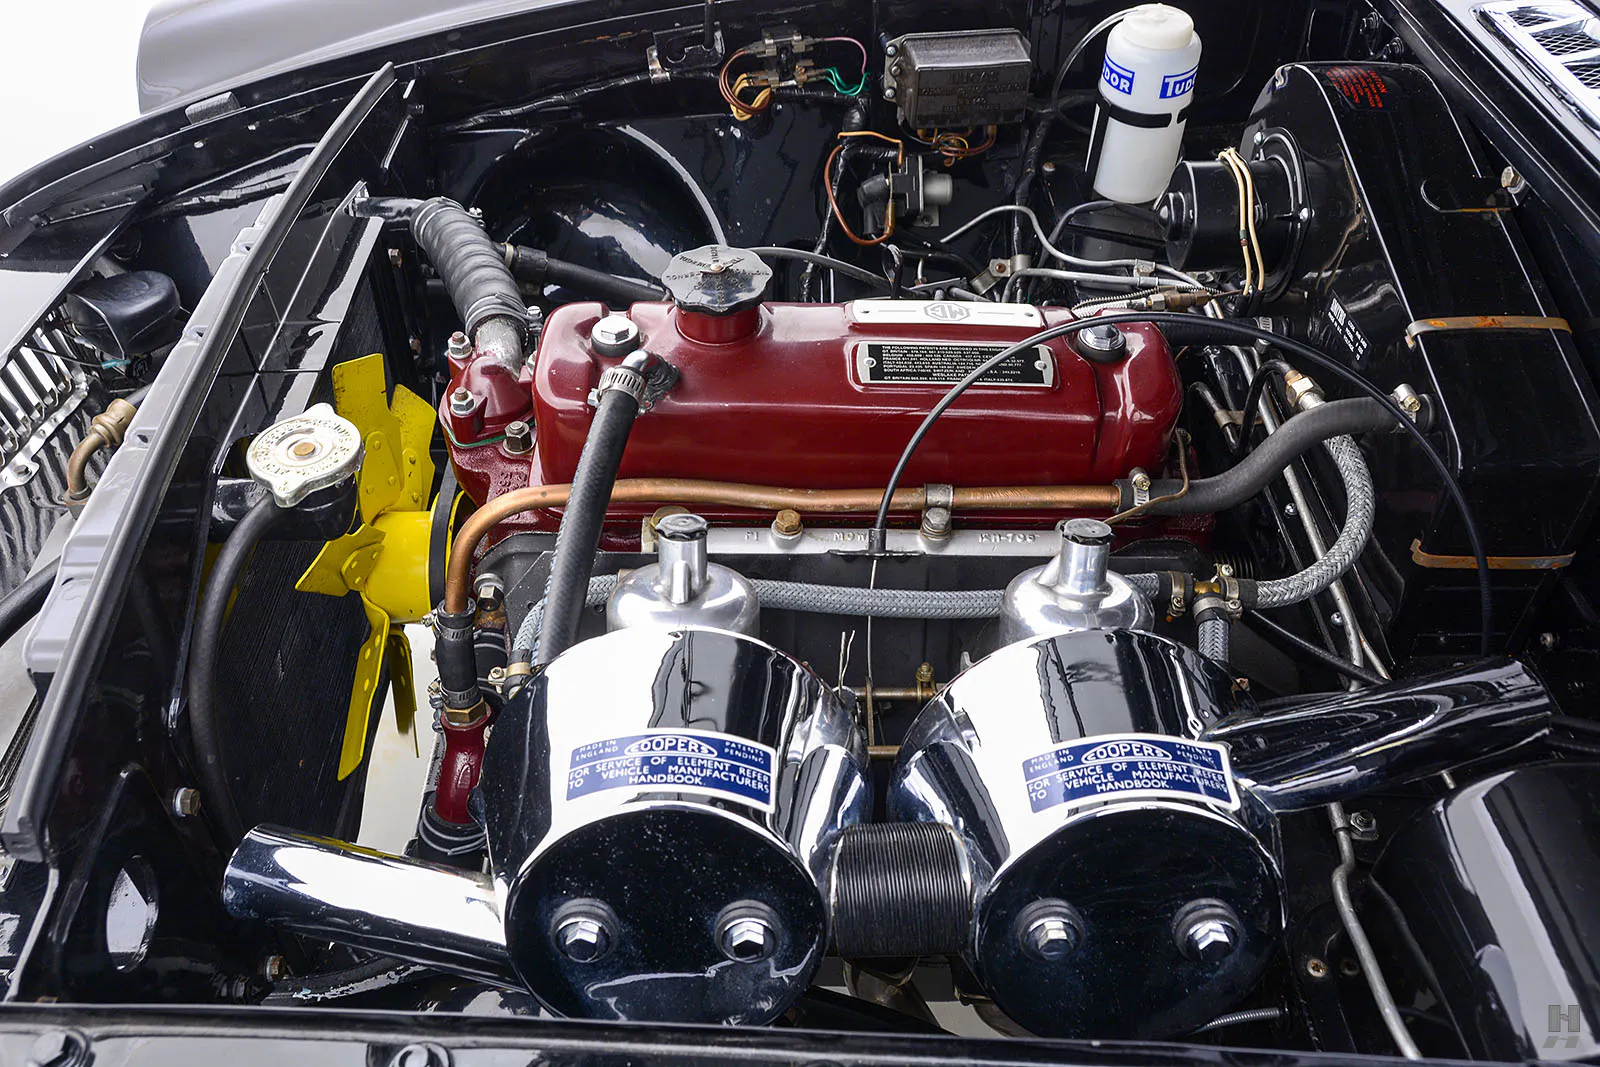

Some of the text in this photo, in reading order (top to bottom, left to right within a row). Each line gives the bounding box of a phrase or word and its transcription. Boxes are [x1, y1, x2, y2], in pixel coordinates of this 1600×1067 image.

[1103, 60, 1132, 93] DOR
[1164, 65, 1198, 97] TUD
[930, 304, 965, 319] MG
[576, 746, 618, 761] ENGLAND
[578, 739, 616, 754] MADE IN
[629, 738, 710, 754] COOPERS
[724, 741, 764, 756] PATENTS
[1086, 744, 1165, 760] COOPERS
[1175, 743, 1213, 756] PATENTS
[724, 748, 765, 764] PENDING
[1029, 754, 1074, 773] ENGLAND
[1030, 748, 1070, 765] MADE IN
[1176, 750, 1214, 764] PENDING
[570, 756, 770, 784] FOR SERVICE OF ELEMENT REFER
[1028, 762, 1225, 792] FOR SERVICE OF ELEMENT REFER
[568, 765, 771, 794] TO VEHICLE MANUFACTURERS
[1030, 770, 1228, 802] TO VEHICLE MANUFACTURERS
